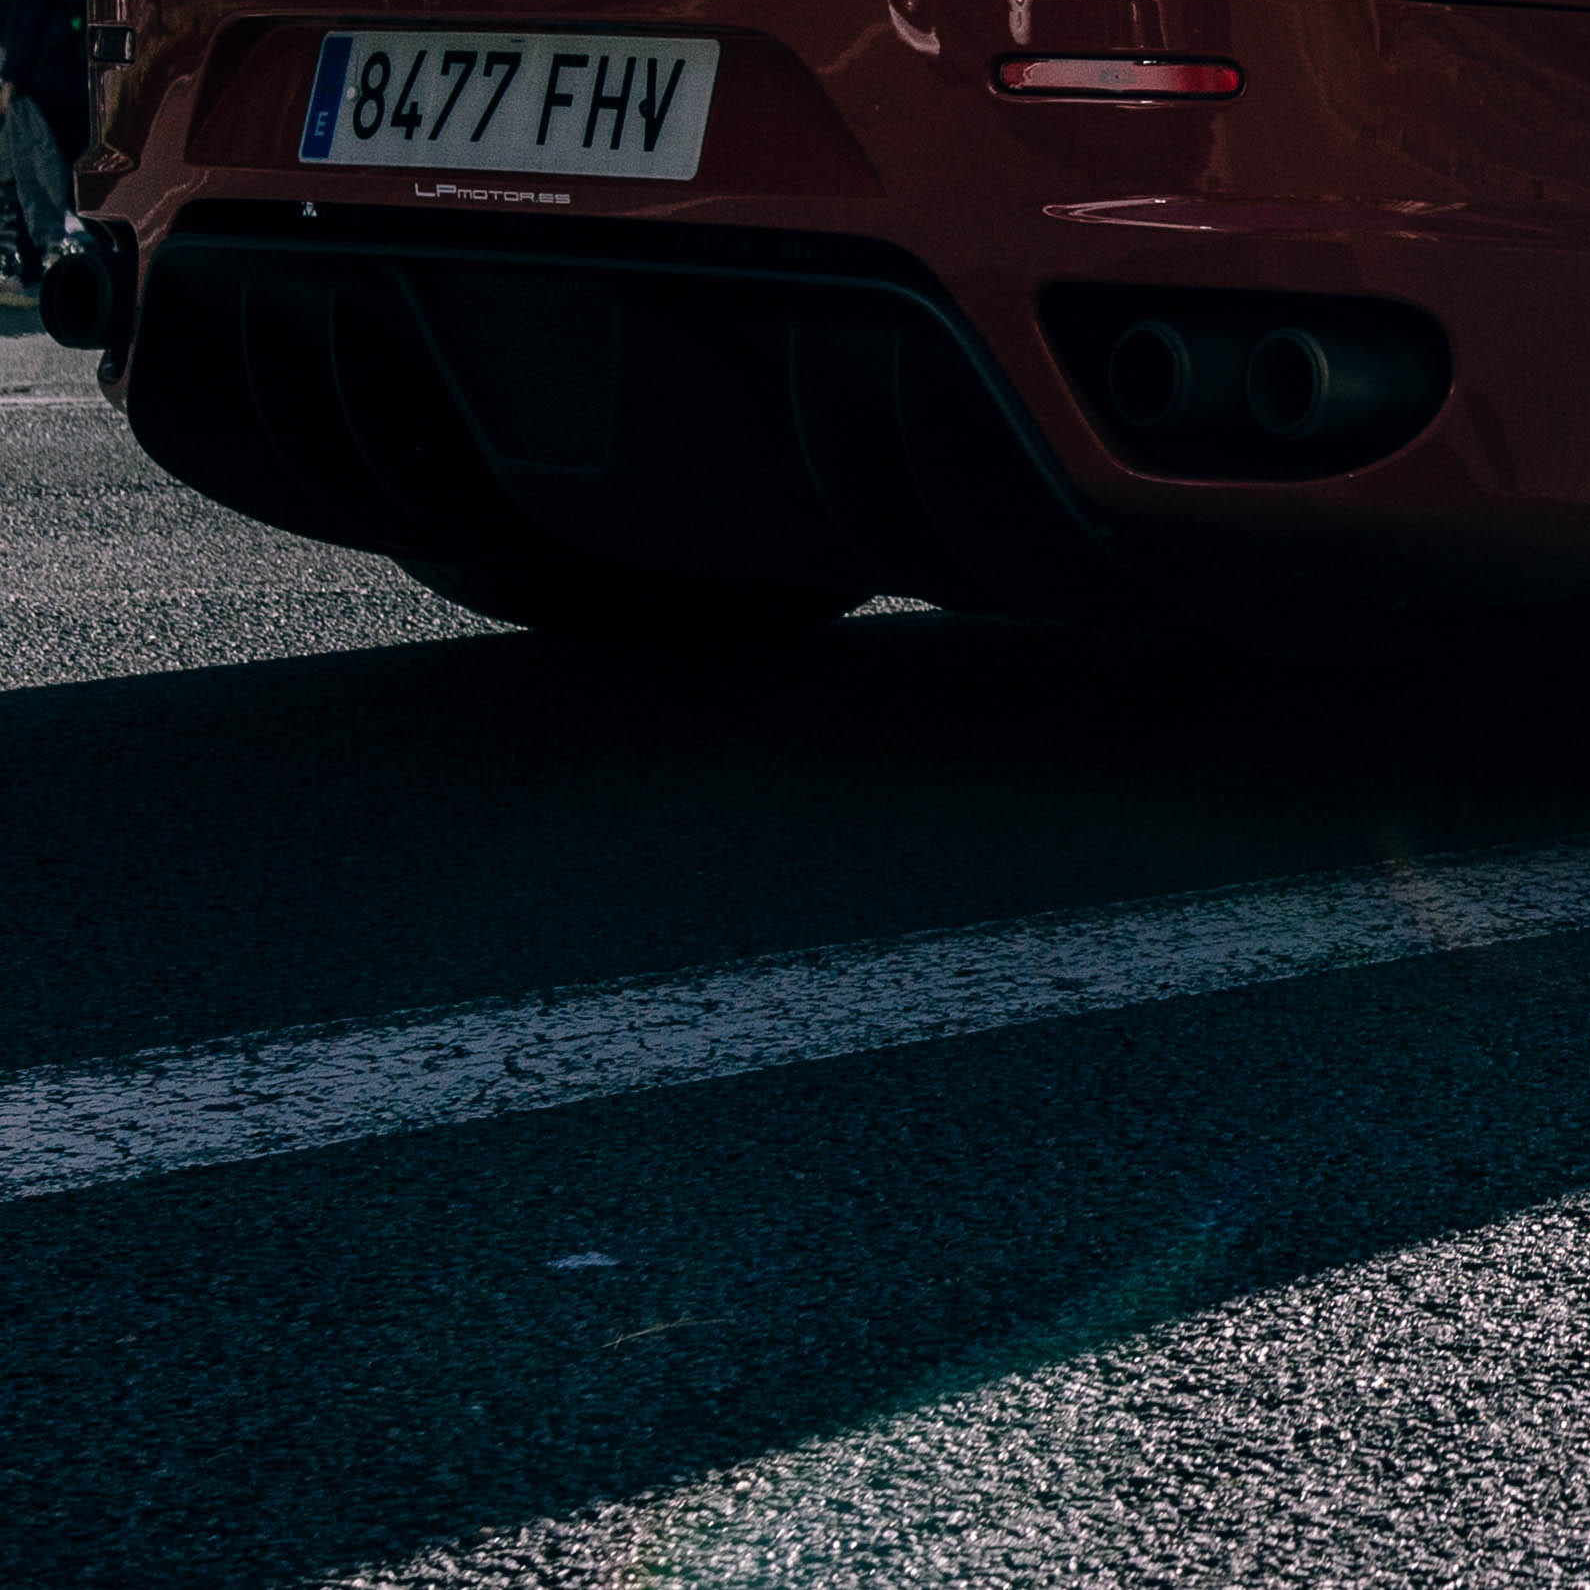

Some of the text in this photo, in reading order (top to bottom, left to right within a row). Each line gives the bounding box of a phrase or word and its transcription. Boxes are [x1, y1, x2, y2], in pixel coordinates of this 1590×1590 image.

[312, 110, 329, 137] E
[351, 49, 686, 152] 8477 FHV
